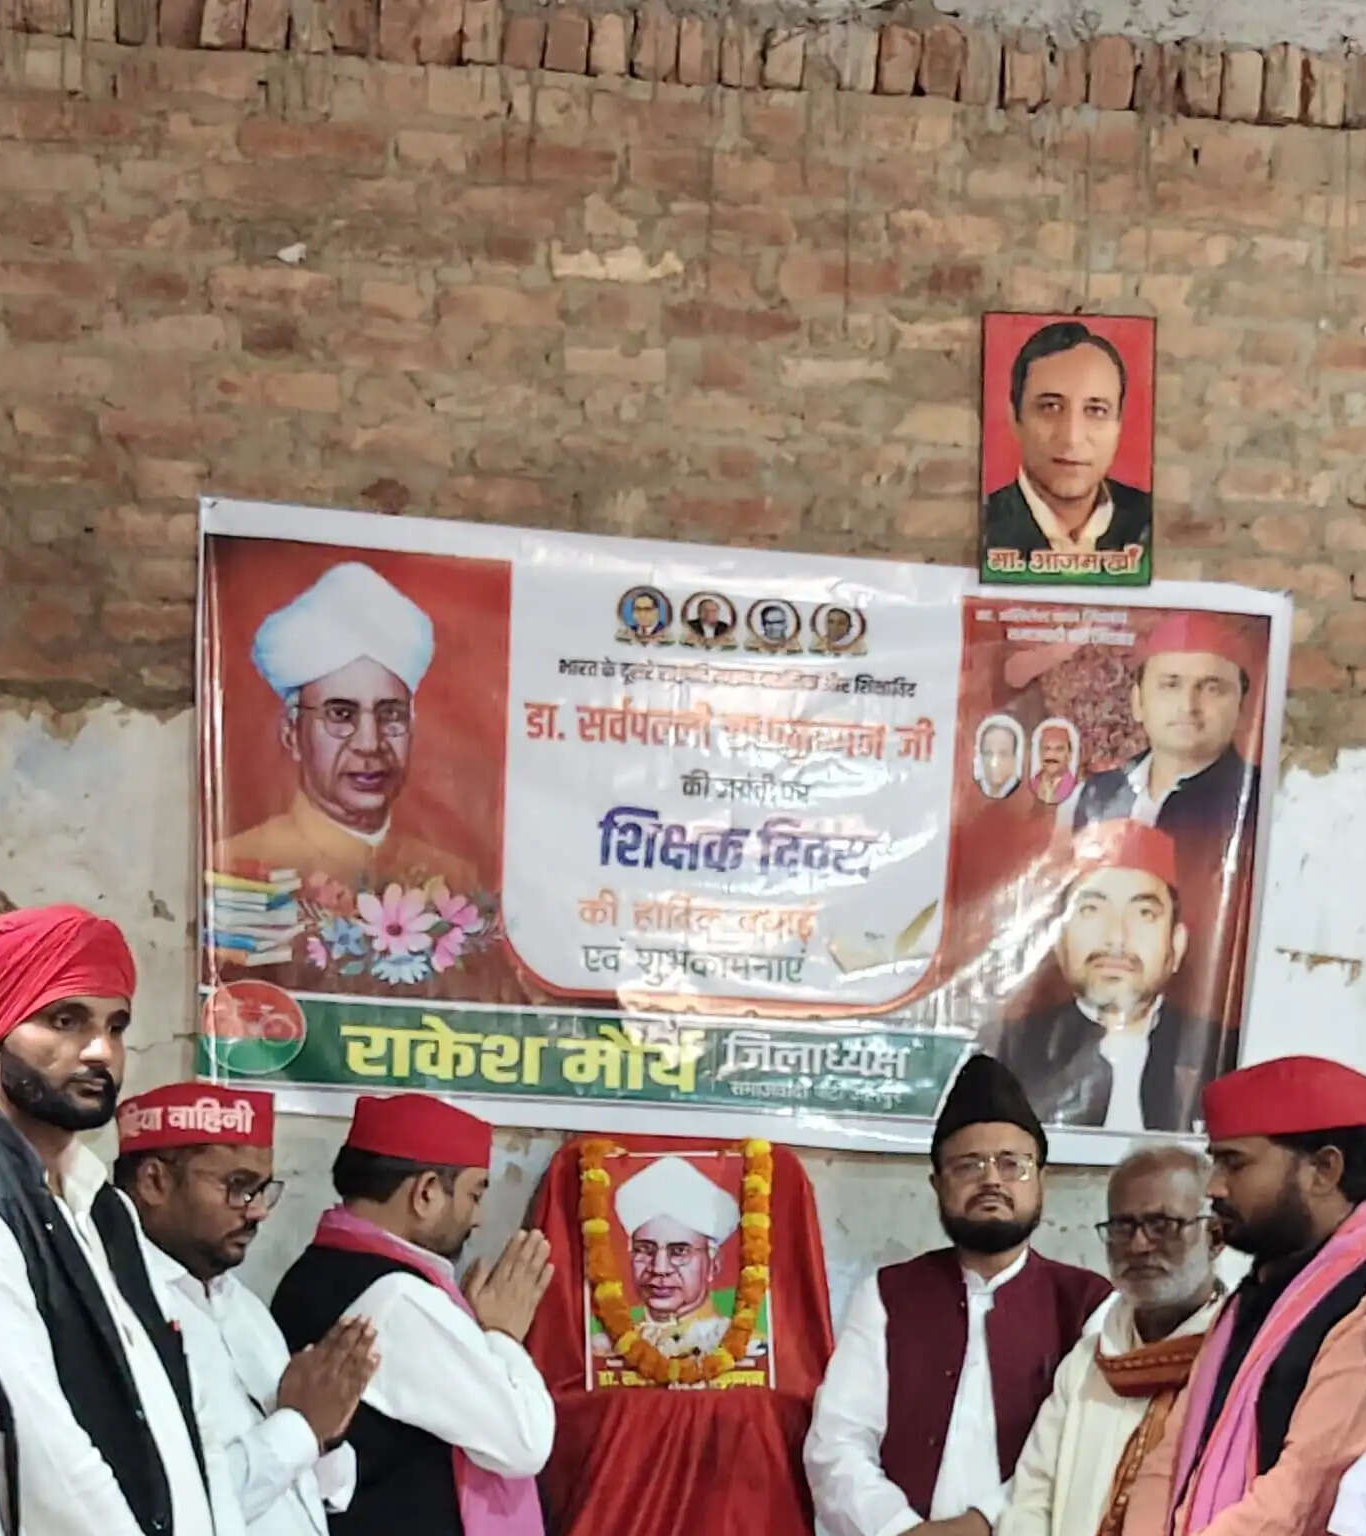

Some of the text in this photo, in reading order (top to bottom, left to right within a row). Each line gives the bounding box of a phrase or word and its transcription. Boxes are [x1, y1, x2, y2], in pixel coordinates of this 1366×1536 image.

[1029, 550, 1101, 574] आजम
[559, 659, 597, 676] भारत
[600, 657, 616, 677] के
[524, 702, 565, 741] डा.
[894, 717, 934, 762] जी
[680, 768, 710, 799] की
[598, 806, 750, 872] शिक्षक
[578, 888, 617, 927] की
[339, 1015, 548, 1085] राकेश
[167, 1096, 255, 1134] वाहिनी
